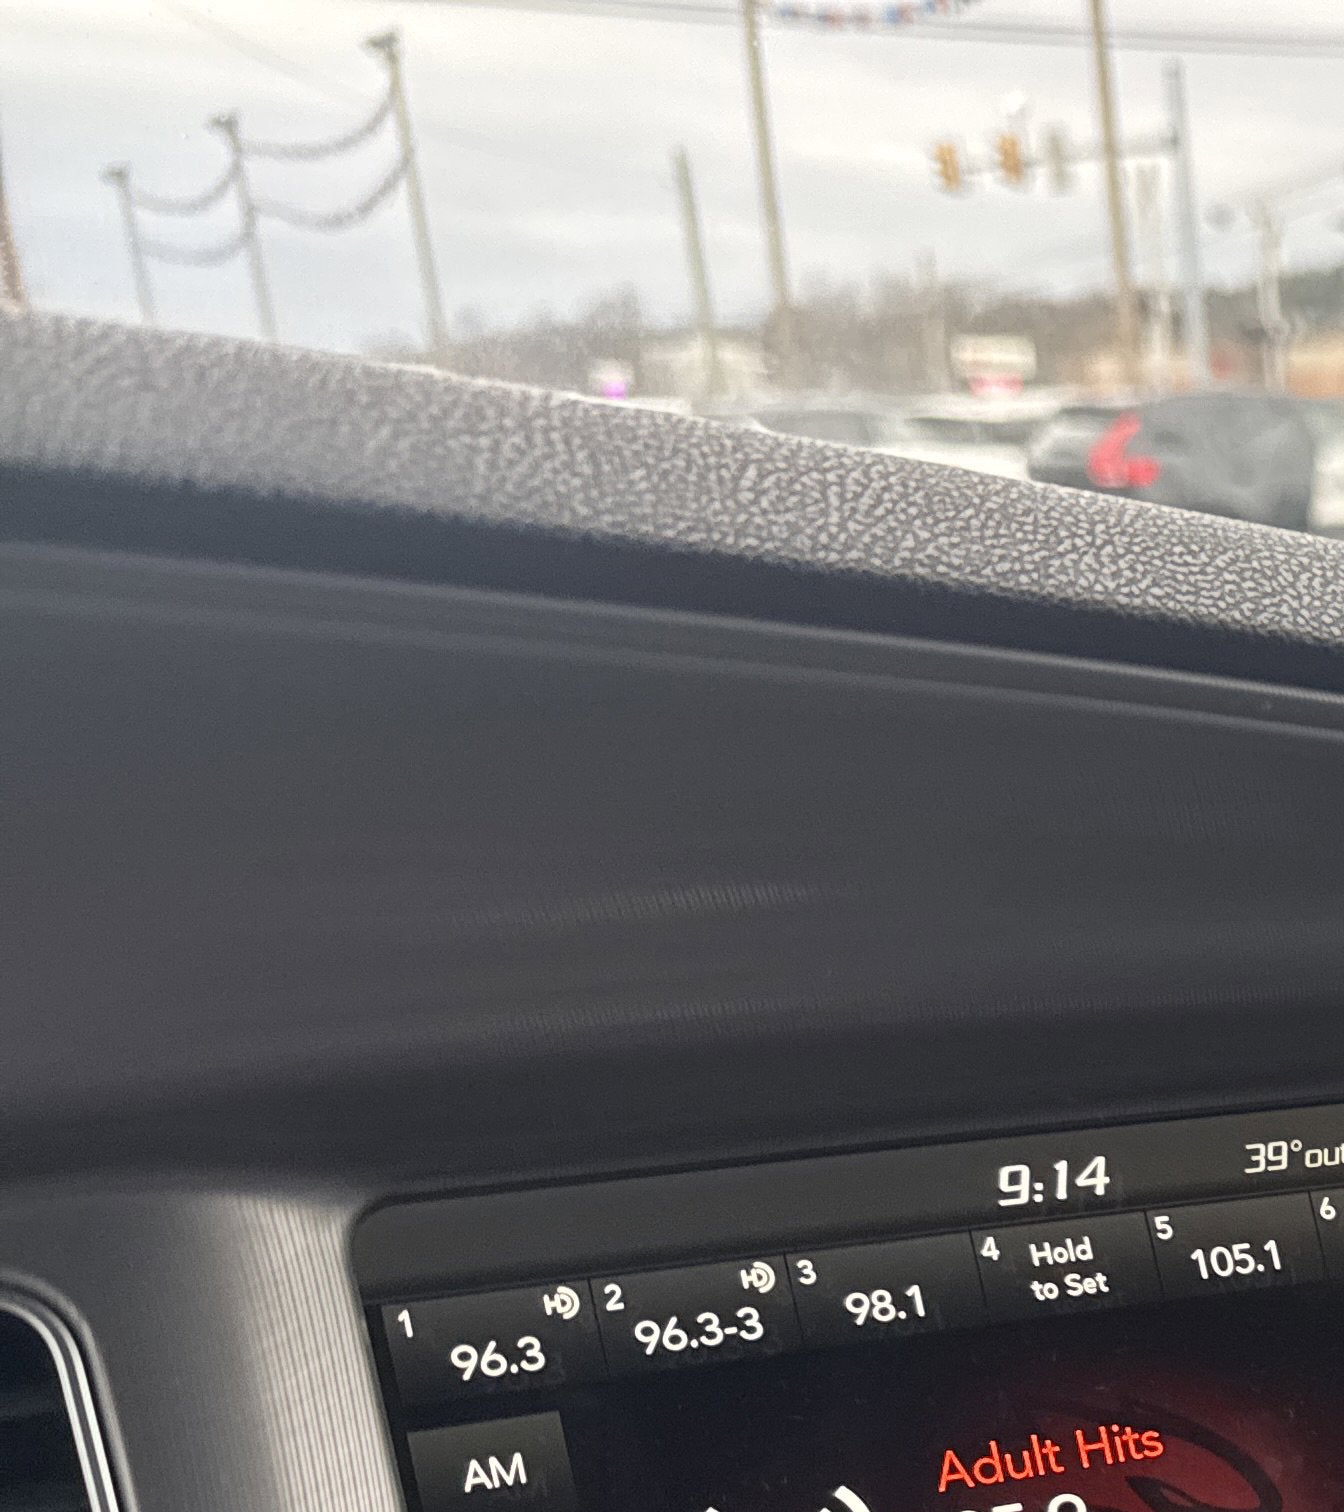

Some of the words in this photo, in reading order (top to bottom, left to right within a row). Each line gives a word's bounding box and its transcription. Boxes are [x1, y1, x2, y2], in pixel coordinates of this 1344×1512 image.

[997, 1155, 1111, 1207] 9:14
[1319, 1196, 1337, 1221] 6
[1154, 1215, 1174, 1240] 5
[980, 1236, 1001, 1262] 4
[1029, 1236, 1094, 1267] Hold
[1190, 1239, 1283, 1280] 105.1
[796, 1259, 818, 1285] 3
[1030, 1279, 1060, 1301] to
[1064, 1272, 1110, 1297] Set
[603, 1283, 625, 1312] 2
[843, 1284, 927, 1326] 98.1
[396, 1309, 414, 1338] 1
[634, 1306, 765, 1356] 96.3-3
[450, 1335, 547, 1381] 96.3
[463, 1452, 528, 1493] AM
[938, 1434, 1065, 1493] Adult
[1074, 1423, 1165, 1470] Hits
